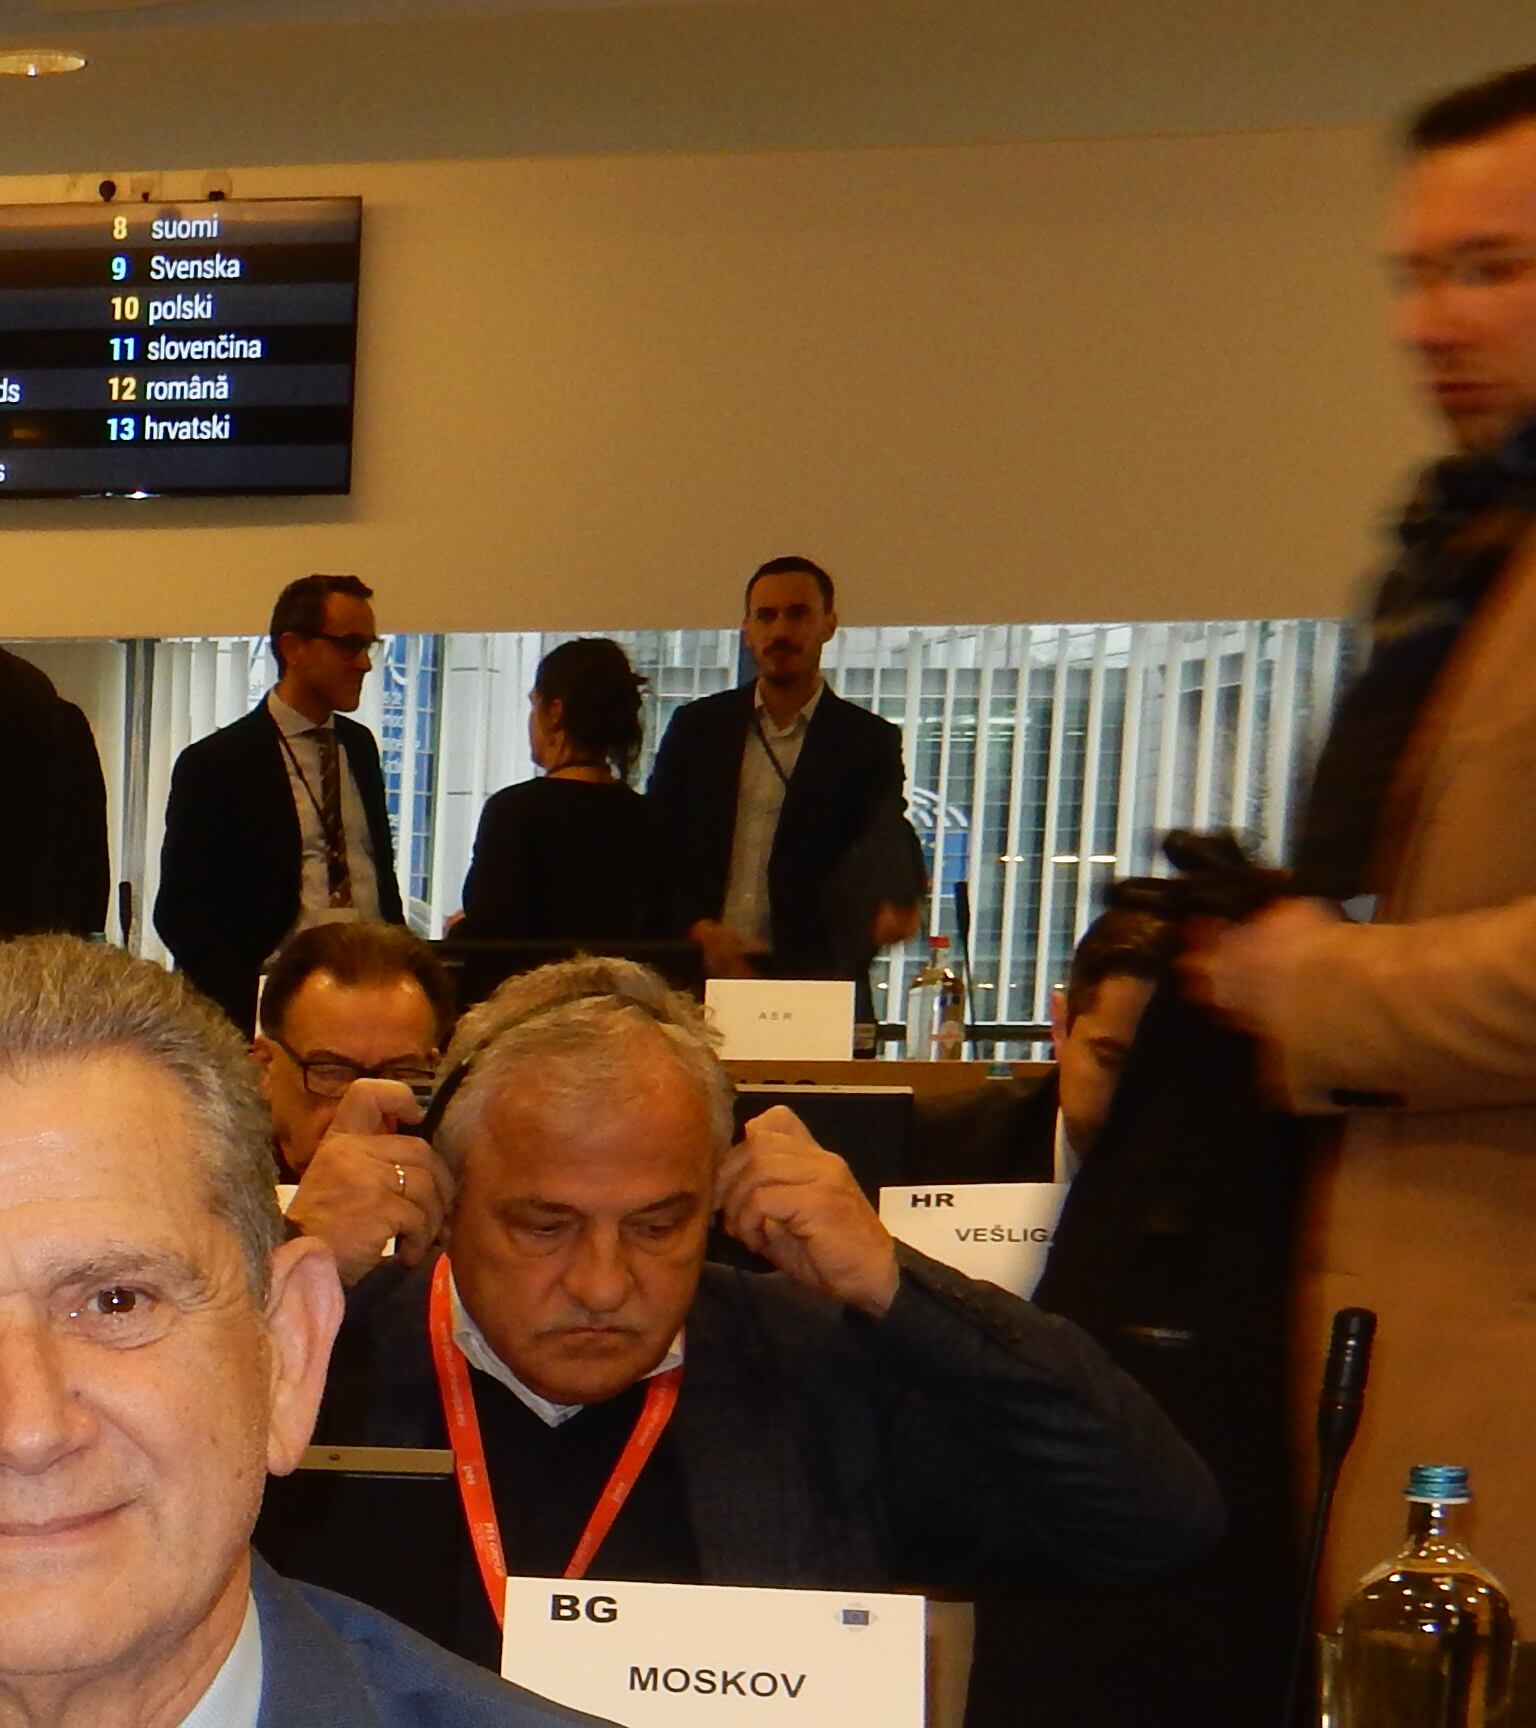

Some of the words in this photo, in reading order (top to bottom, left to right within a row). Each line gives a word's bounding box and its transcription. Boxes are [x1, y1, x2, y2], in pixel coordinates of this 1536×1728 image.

[112, 215, 128, 240] 8
[151, 213, 219, 240] suomi
[111, 257, 127, 281] 9
[149, 253, 241, 280] Svenska
[111, 296, 139, 321] 10
[148, 293, 213, 325] polski
[109, 337, 135, 361] 11
[147, 334, 262, 361] slovenčina
[108, 377, 137, 401] 12
[145, 374, 229, 401] română
[106, 418, 136, 441] 13
[144, 413, 231, 441] hrvatski
[911, 1193, 955, 1208] HR
[955, 1224, 1052, 1243] VEŠLIG
[550, 1594, 619, 1624] BG
[628, 1666, 807, 1699] MOSKOV
